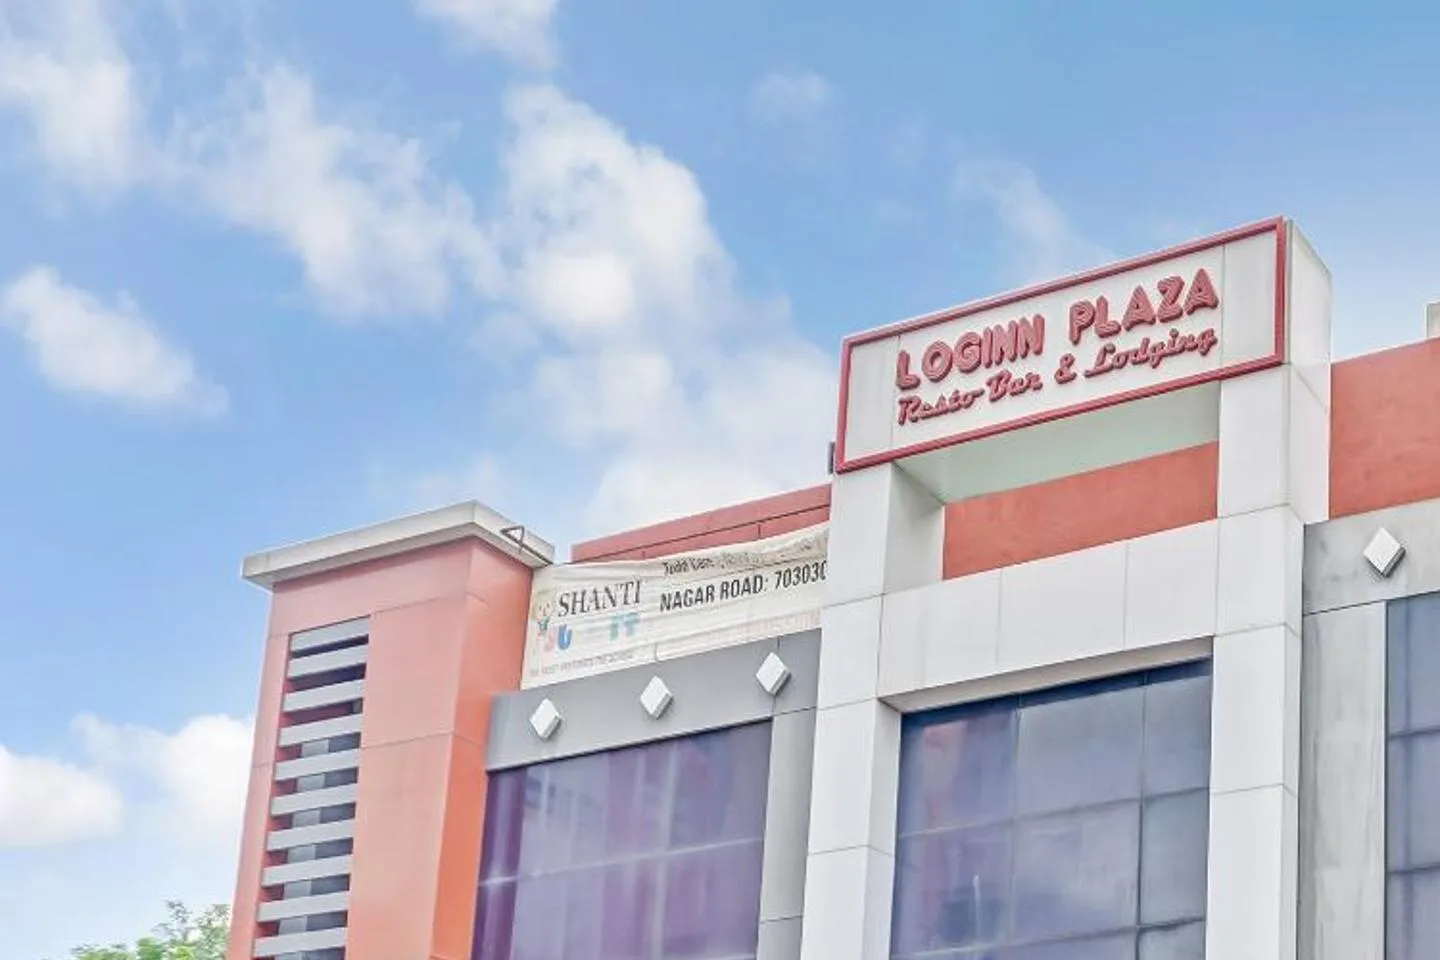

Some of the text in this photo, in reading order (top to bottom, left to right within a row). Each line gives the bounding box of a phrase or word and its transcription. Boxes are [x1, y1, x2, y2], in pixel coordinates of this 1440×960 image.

[896, 268, 1219, 391] LOGINN PLAZA
[1054, 353, 1077, 385] &
[1084, 328, 1218, 379] Lodging
[557, 579, 643, 618] SHANTI
[659, 583, 716, 613] NAGAR
[719, 573, 770, 601] ROAD:
